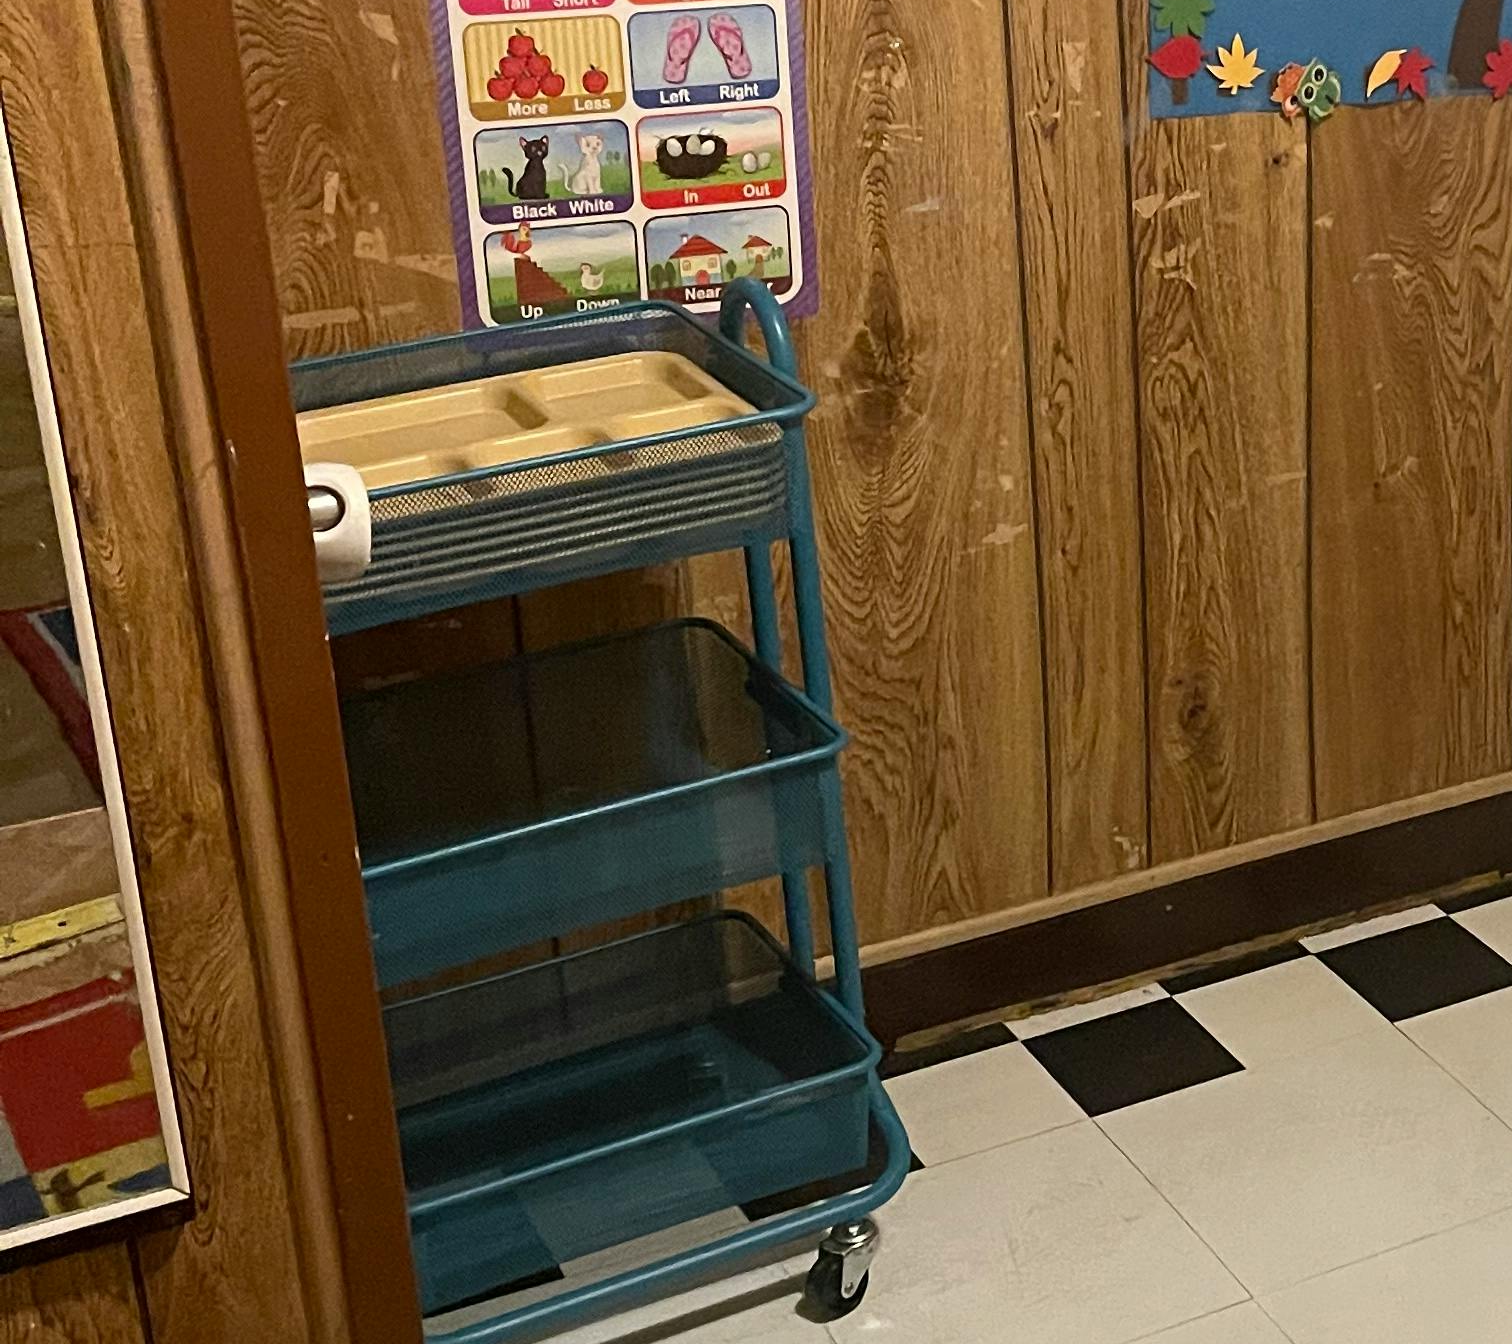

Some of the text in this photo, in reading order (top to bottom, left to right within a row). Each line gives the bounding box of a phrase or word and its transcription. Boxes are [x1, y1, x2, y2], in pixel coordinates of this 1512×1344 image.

[659, 84, 760, 105] Left Right
[508, 96, 612, 117] More Less
[683, 184, 771, 205] In Out
[512, 199, 615, 221] Black White
[685, 287, 721, 301] Near
[520, 303, 544, 320] Up
